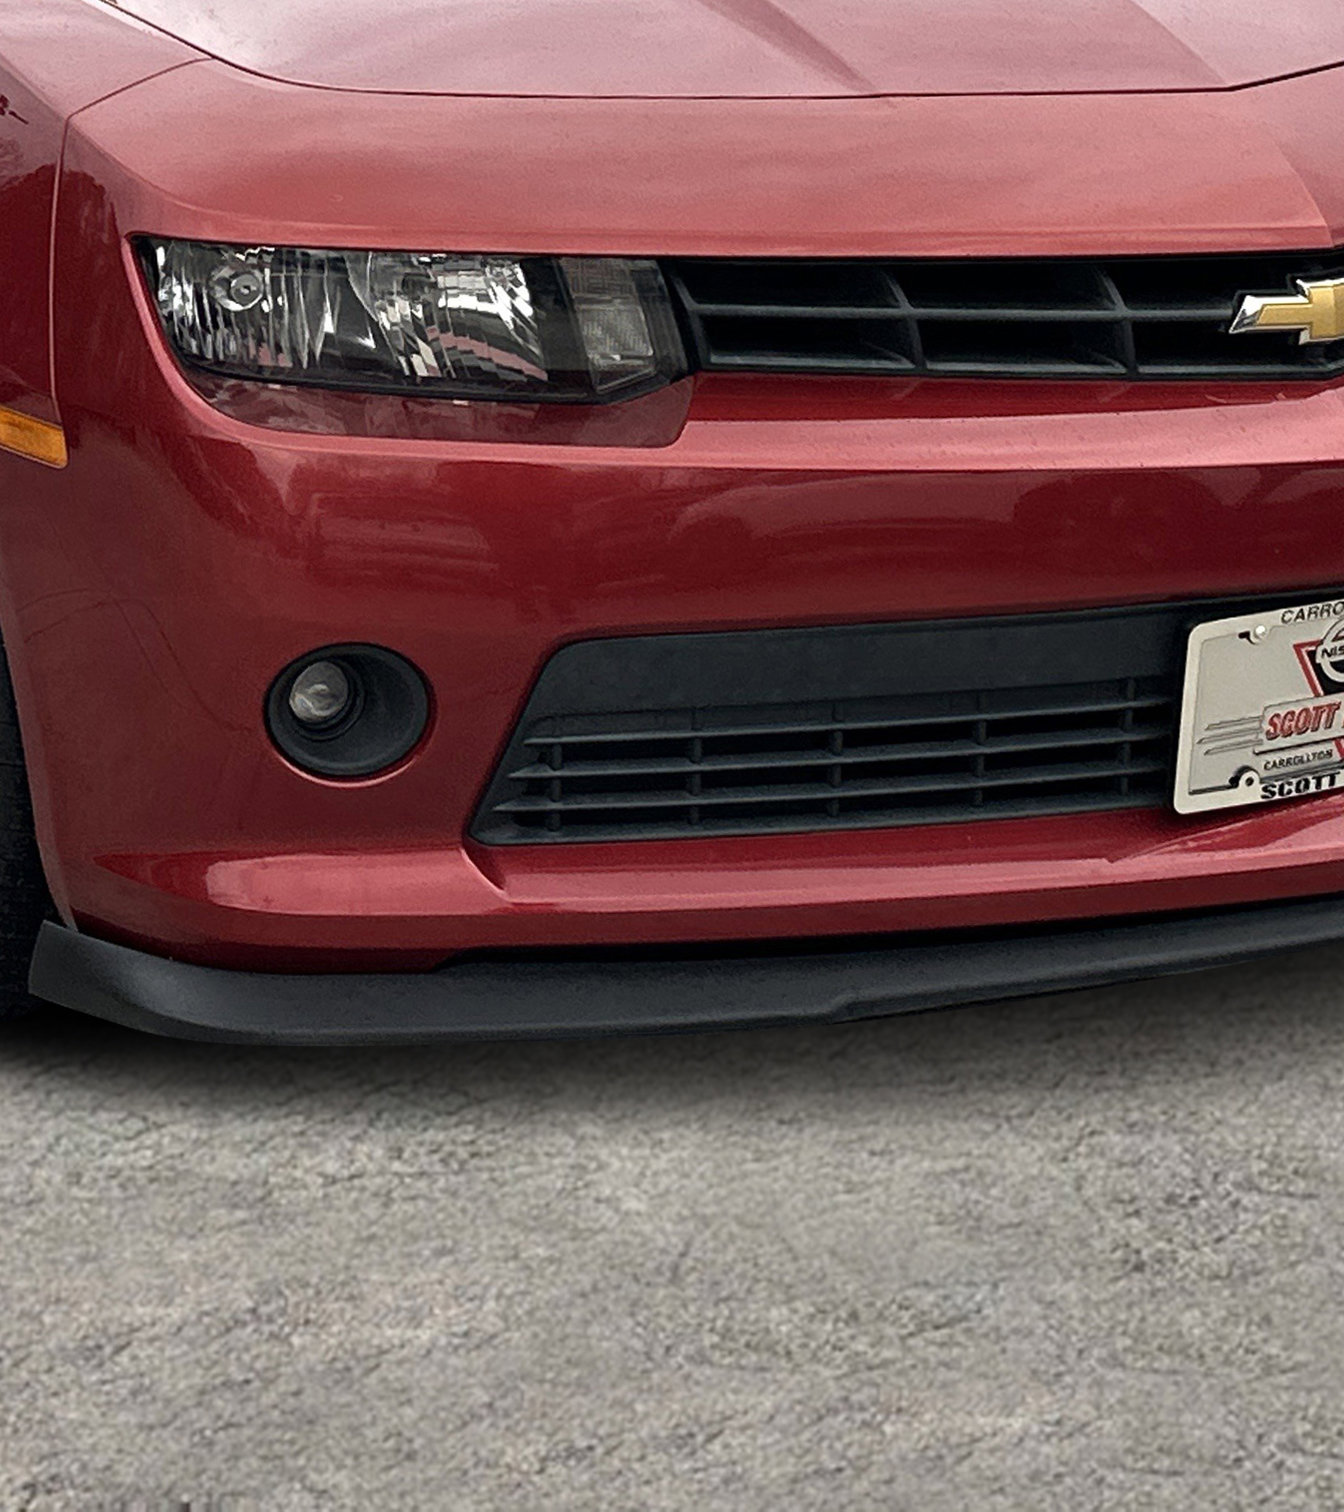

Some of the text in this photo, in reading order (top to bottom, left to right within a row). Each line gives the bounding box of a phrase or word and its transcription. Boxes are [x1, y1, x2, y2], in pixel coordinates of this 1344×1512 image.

[1265, 701, 1342, 741] SCOTT
[1263, 748, 1334, 771] CARROLLTON
[1260, 771, 1341, 800] SCOTT
